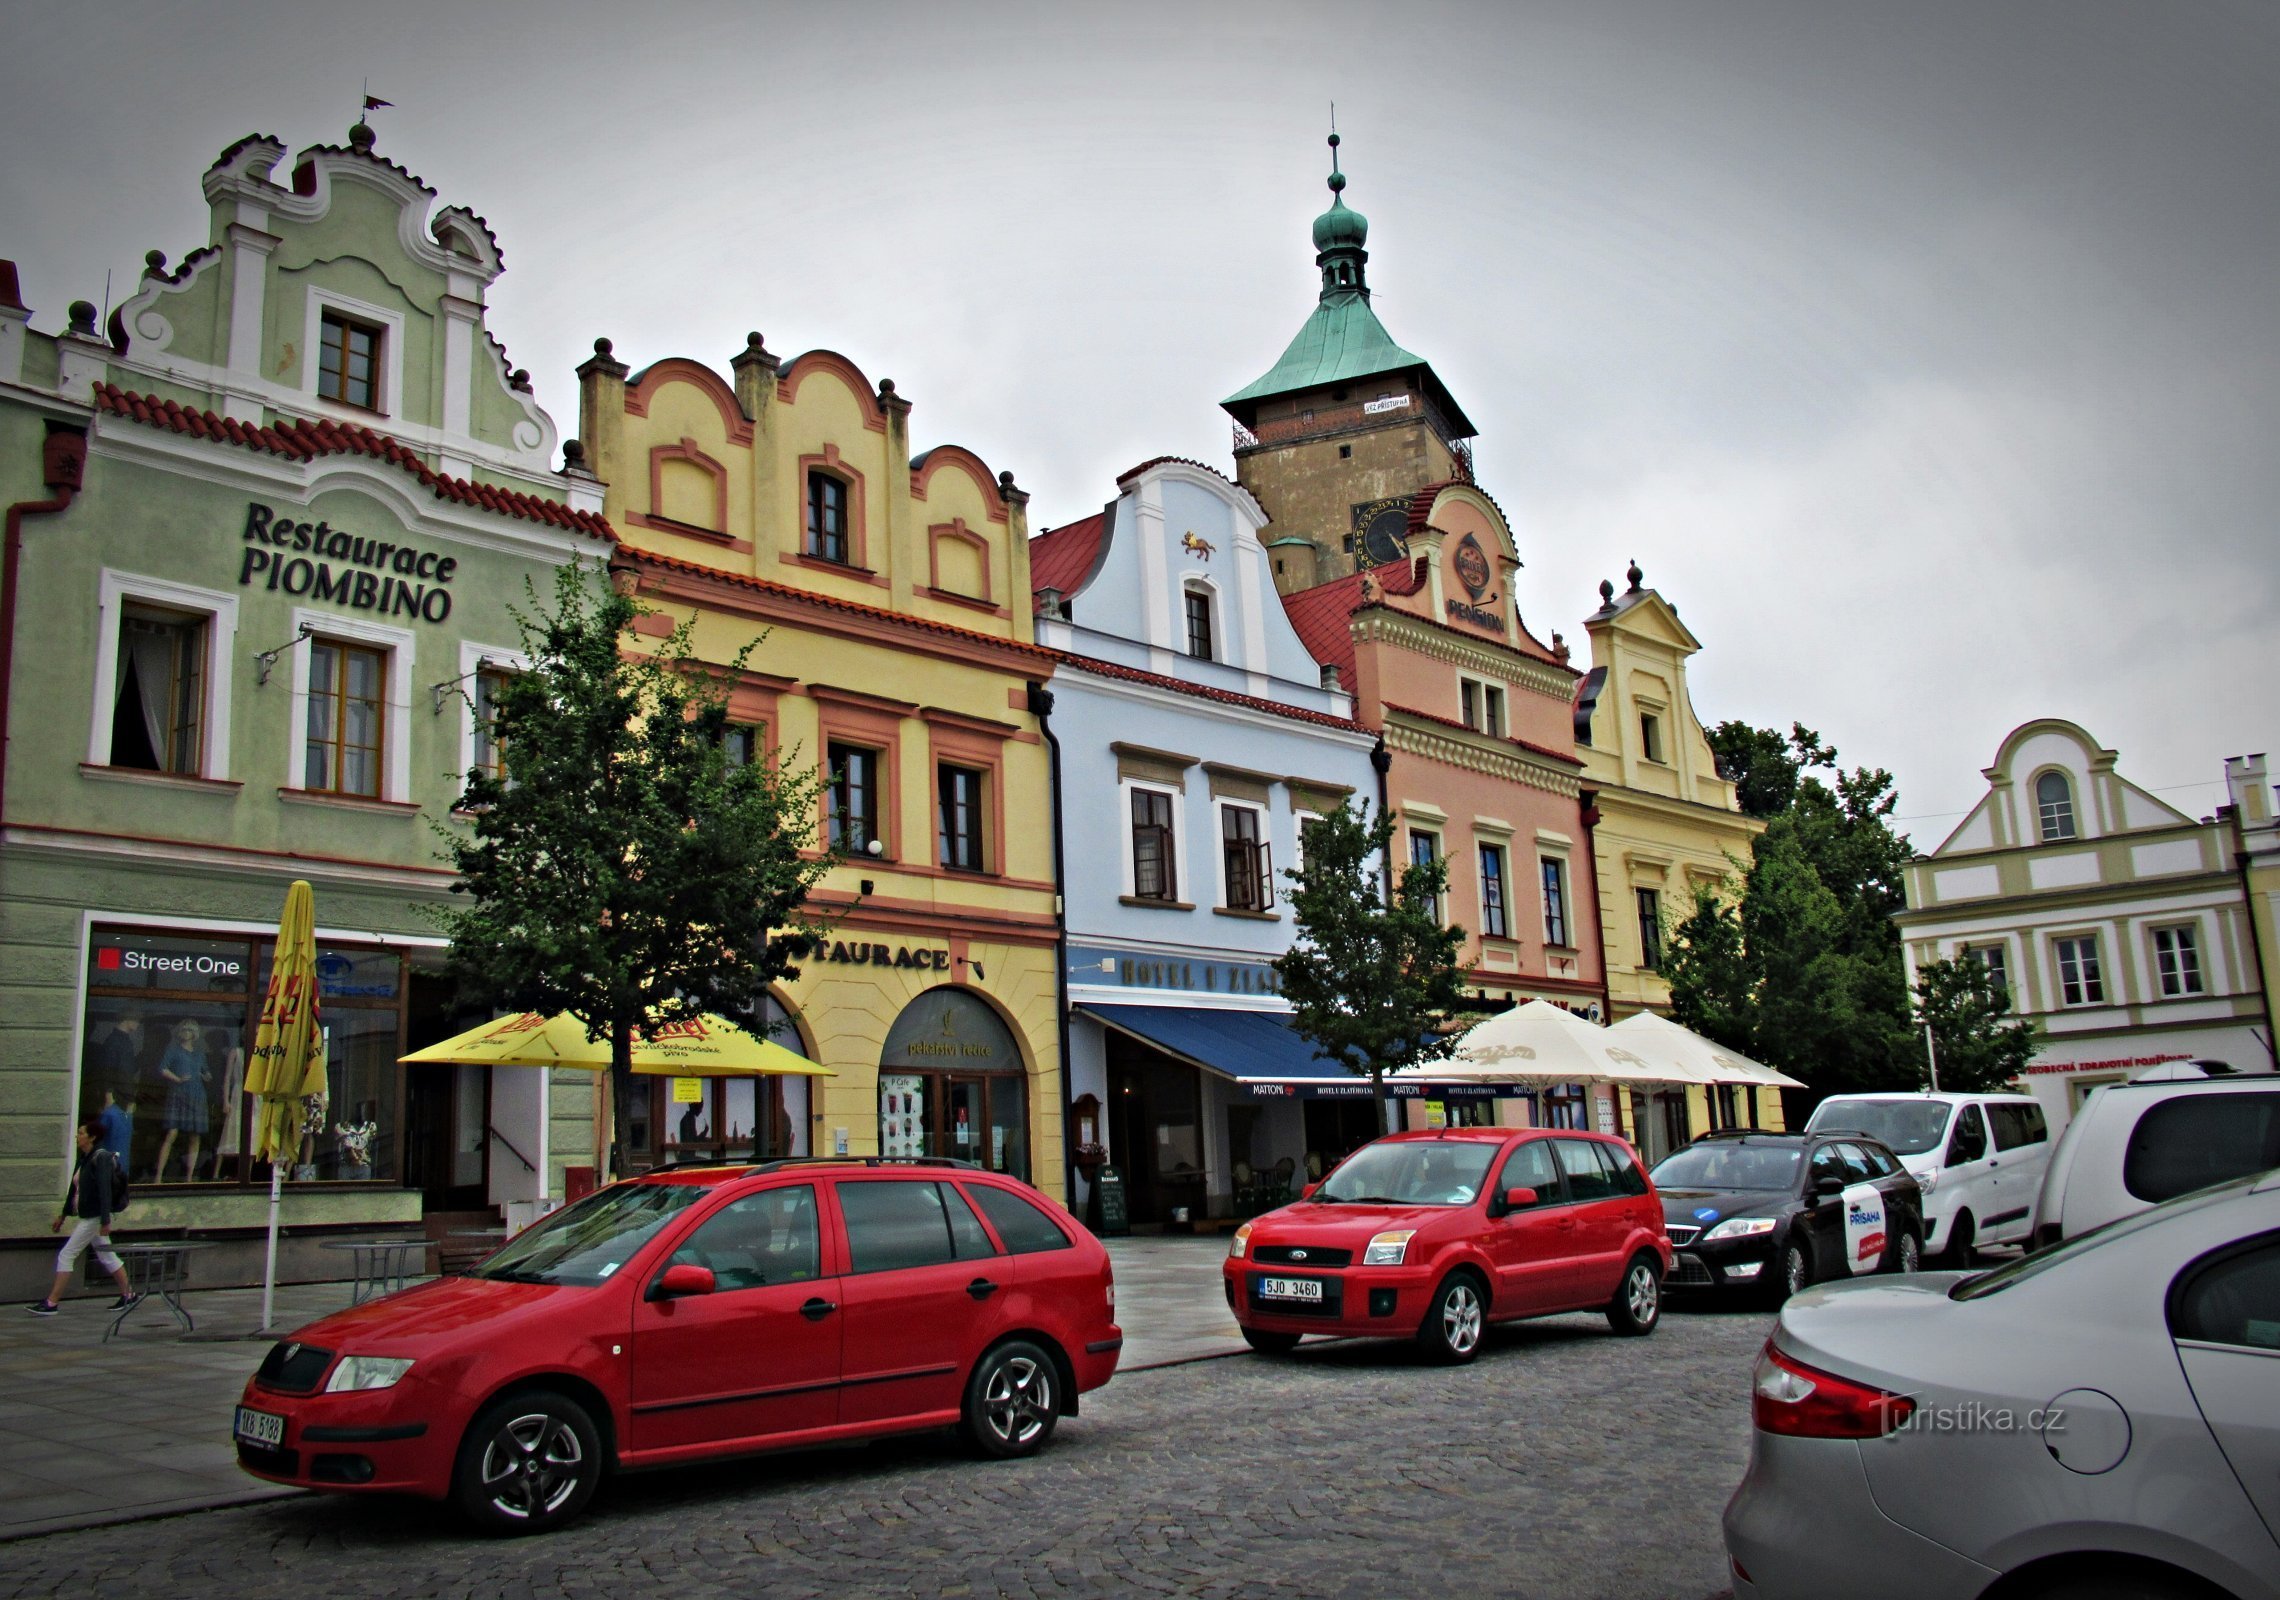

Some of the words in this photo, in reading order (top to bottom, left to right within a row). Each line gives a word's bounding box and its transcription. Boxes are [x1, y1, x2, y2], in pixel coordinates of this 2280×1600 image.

[244, 502, 458, 582] Restaurace
[240, 547, 452, 623] PIOMBINO
[1447, 598, 1505, 633] PENSION
[124, 951, 193, 973] Street
[196, 956, 240, 975] One
[1122, 959, 1195, 989] HOTEL
[2079, 1056, 2134, 1071] ZDRAVOTNÍ
[1253, 1084, 1284, 1095] MATTONI
[1317, 1086, 1335, 1095] HOTEL
[1393, 1085, 1420, 1095] MATTONI
[1266, 1280, 1285, 1293] 5J0
[1292, 1282, 1318, 1296] 3460
